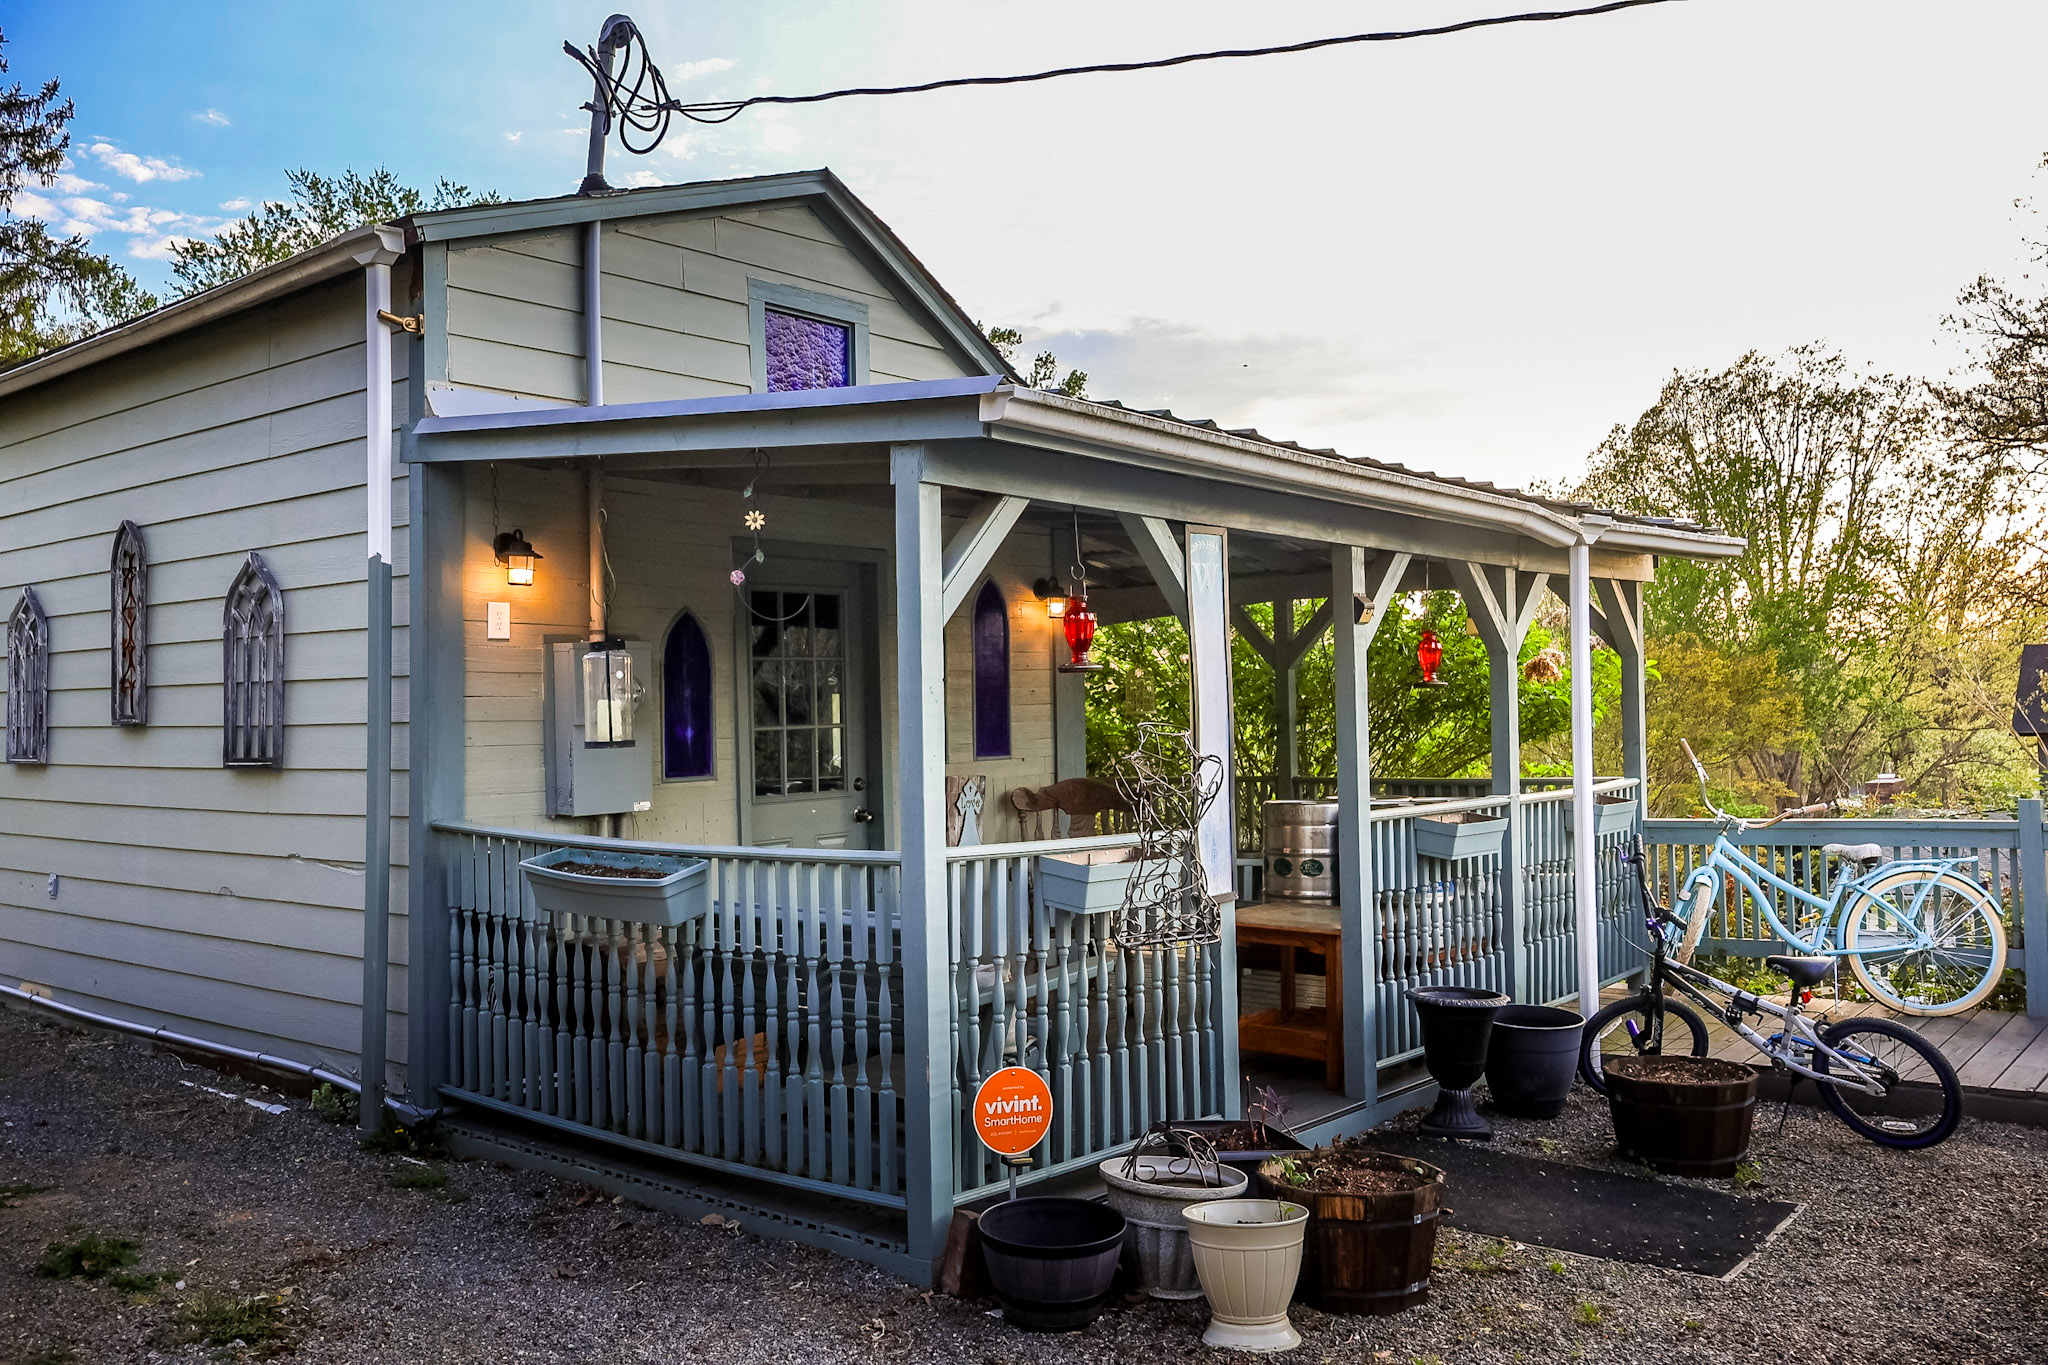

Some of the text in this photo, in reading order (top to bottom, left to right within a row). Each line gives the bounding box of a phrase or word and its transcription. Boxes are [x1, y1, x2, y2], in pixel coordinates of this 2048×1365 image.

[960, 796, 981, 809] Love
[984, 1095, 1043, 1115] vivint.
[984, 1115, 1042, 1128] SmartHome
